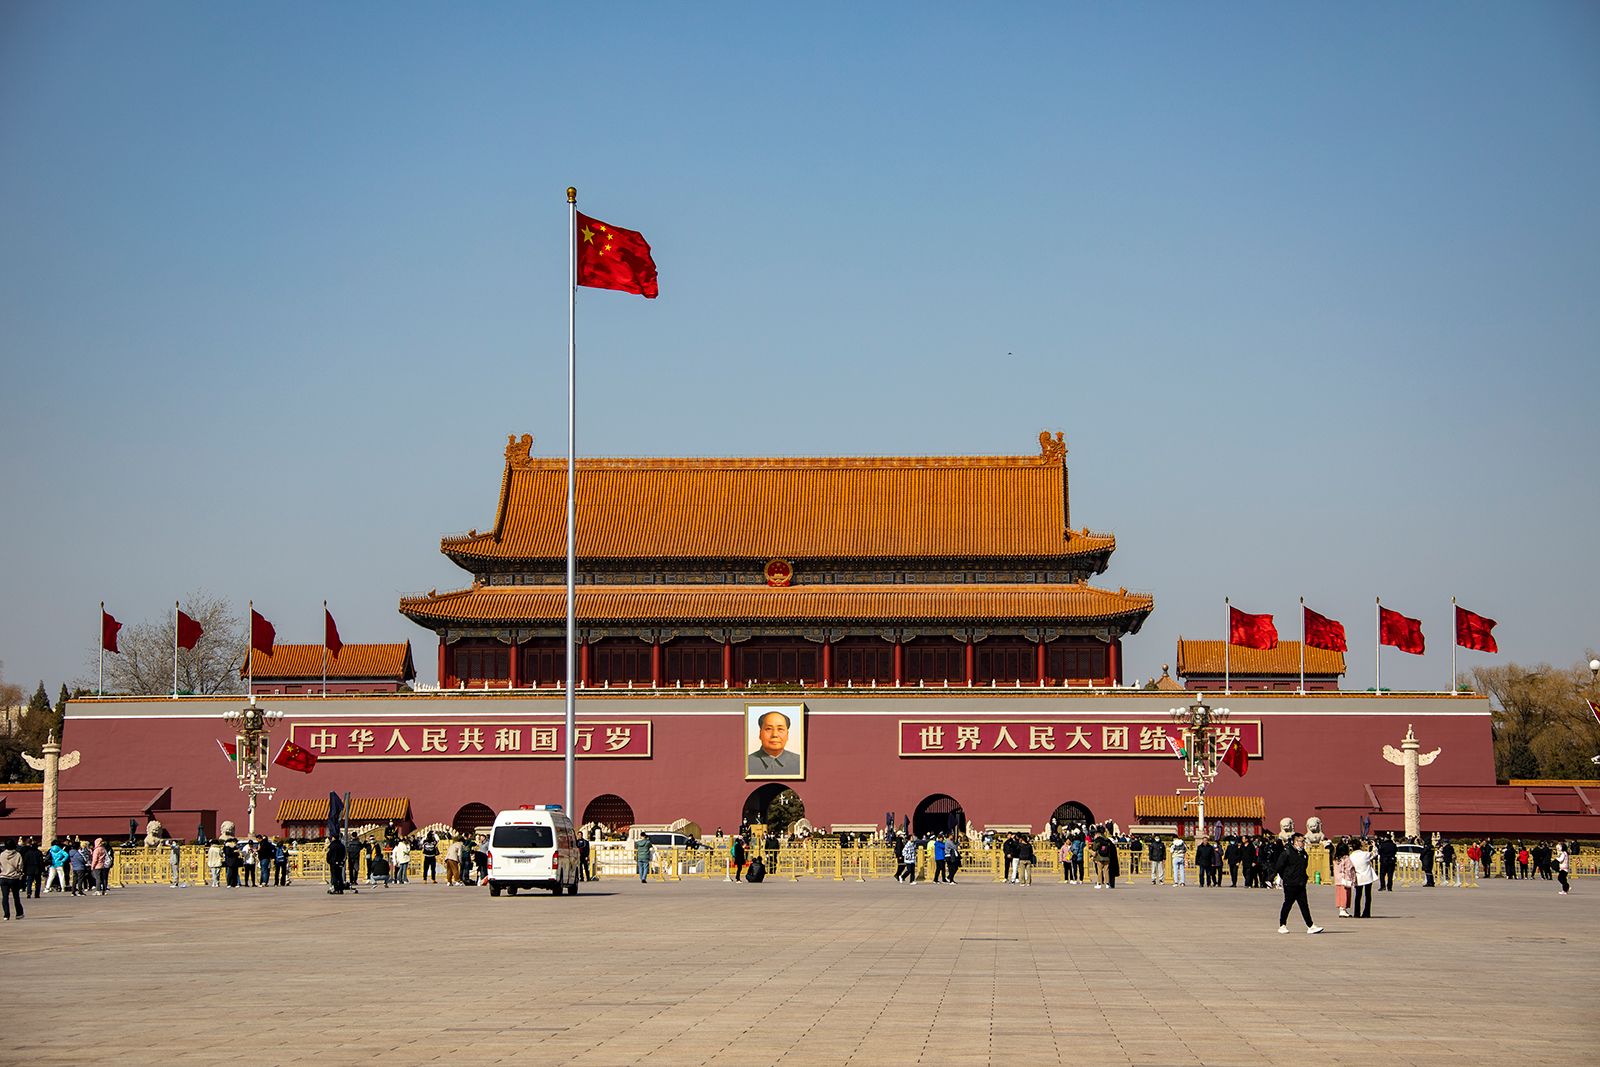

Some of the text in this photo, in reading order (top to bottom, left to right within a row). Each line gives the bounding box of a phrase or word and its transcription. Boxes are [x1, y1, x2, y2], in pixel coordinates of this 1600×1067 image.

[310, 727, 632, 753] 中华人民共和国万岁
[919, 726, 1241, 751] 世界人民大团结岁
